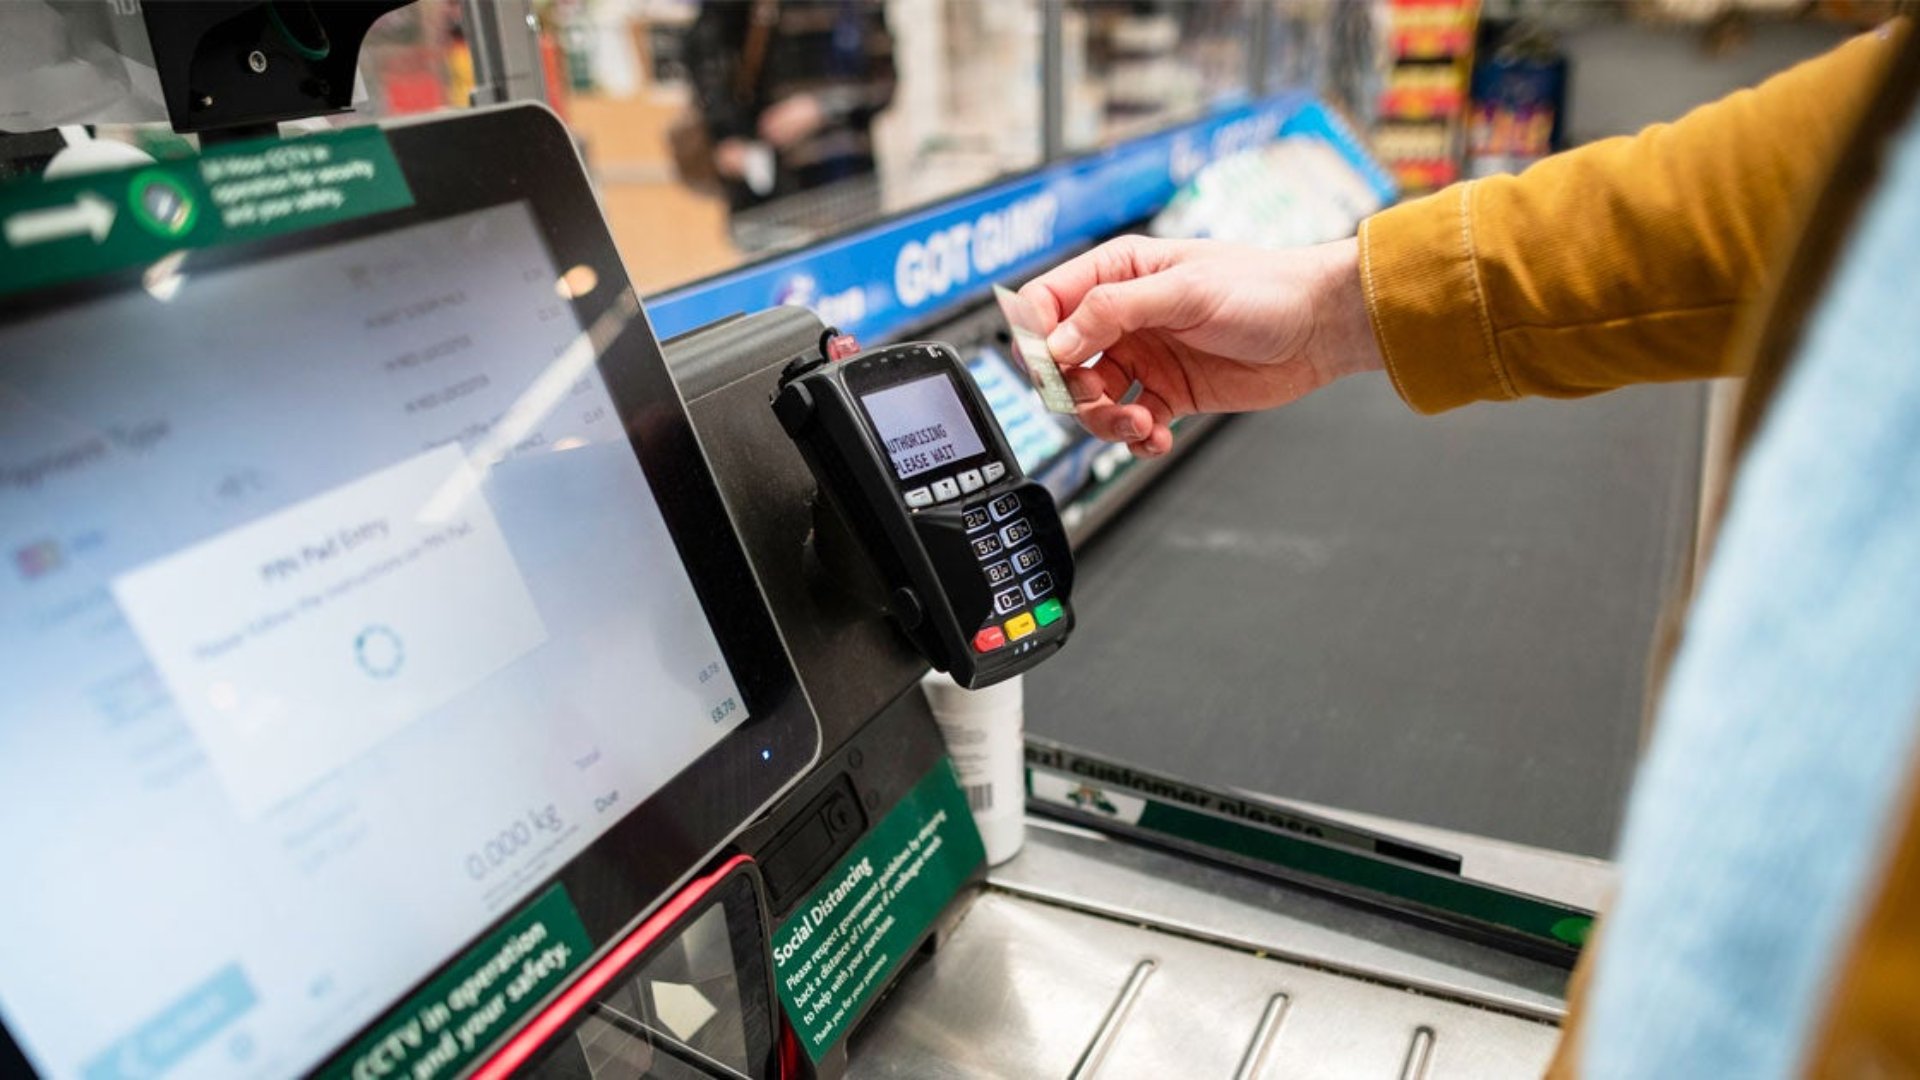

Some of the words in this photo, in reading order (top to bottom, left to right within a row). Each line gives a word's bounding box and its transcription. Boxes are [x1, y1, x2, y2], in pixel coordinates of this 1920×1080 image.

[265, 145, 311, 170] CCTV
[313, 144, 329, 162] in
[211, 174, 289, 206] operation
[288, 167, 315, 190] for
[316, 159, 375, 184] security
[257, 199, 294, 226] your
[894, 221, 972, 307] GOT
[929, 443, 956, 464] WAIT
[964, 514, 976, 528] 2
[996, 501, 1008, 514] 3
[339, 517, 391, 551] Entry
[978, 541, 989, 555] 5
[1008, 526, 1019, 540] 6
[990, 568, 1000, 581] 8
[1019, 554, 1030, 567] 9
[1001, 595, 1012, 608] 0
[1071, 757, 1208, 807] customer
[593, 790, 620, 814] Due
[466, 819, 532, 881] 0.000
[527, 802, 563, 833] kg
[773, 915, 814, 968] Social
[810, 856, 874, 928] Distancing
[786, 961, 813, 991] Please
[811, 927, 840, 964] respect
[839, 880, 880, 936] government
[793, 983, 816, 1009] back
[814, 976, 822, 988] a
[820, 942, 851, 980] distance
[849, 926, 860, 947] of
[862, 902, 885, 932] metre
[352, 1014, 423, 1080] CCTV
[418, 1001, 452, 1033] in
[447, 922, 548, 1011] operation
[803, 1010, 815, 1026] to
[812, 990, 833, 1016] help
[831, 969, 850, 993] with
[847, 950, 865, 977] your
[412, 1028, 460, 1080] and
[454, 992, 507, 1052] your
[505, 941, 572, 1002] safety.
[813, 1018, 833, 1046] Thank
[831, 1007, 846, 1027] you
[842, 995, 854, 1012] for
[852, 981, 866, 1003] your
